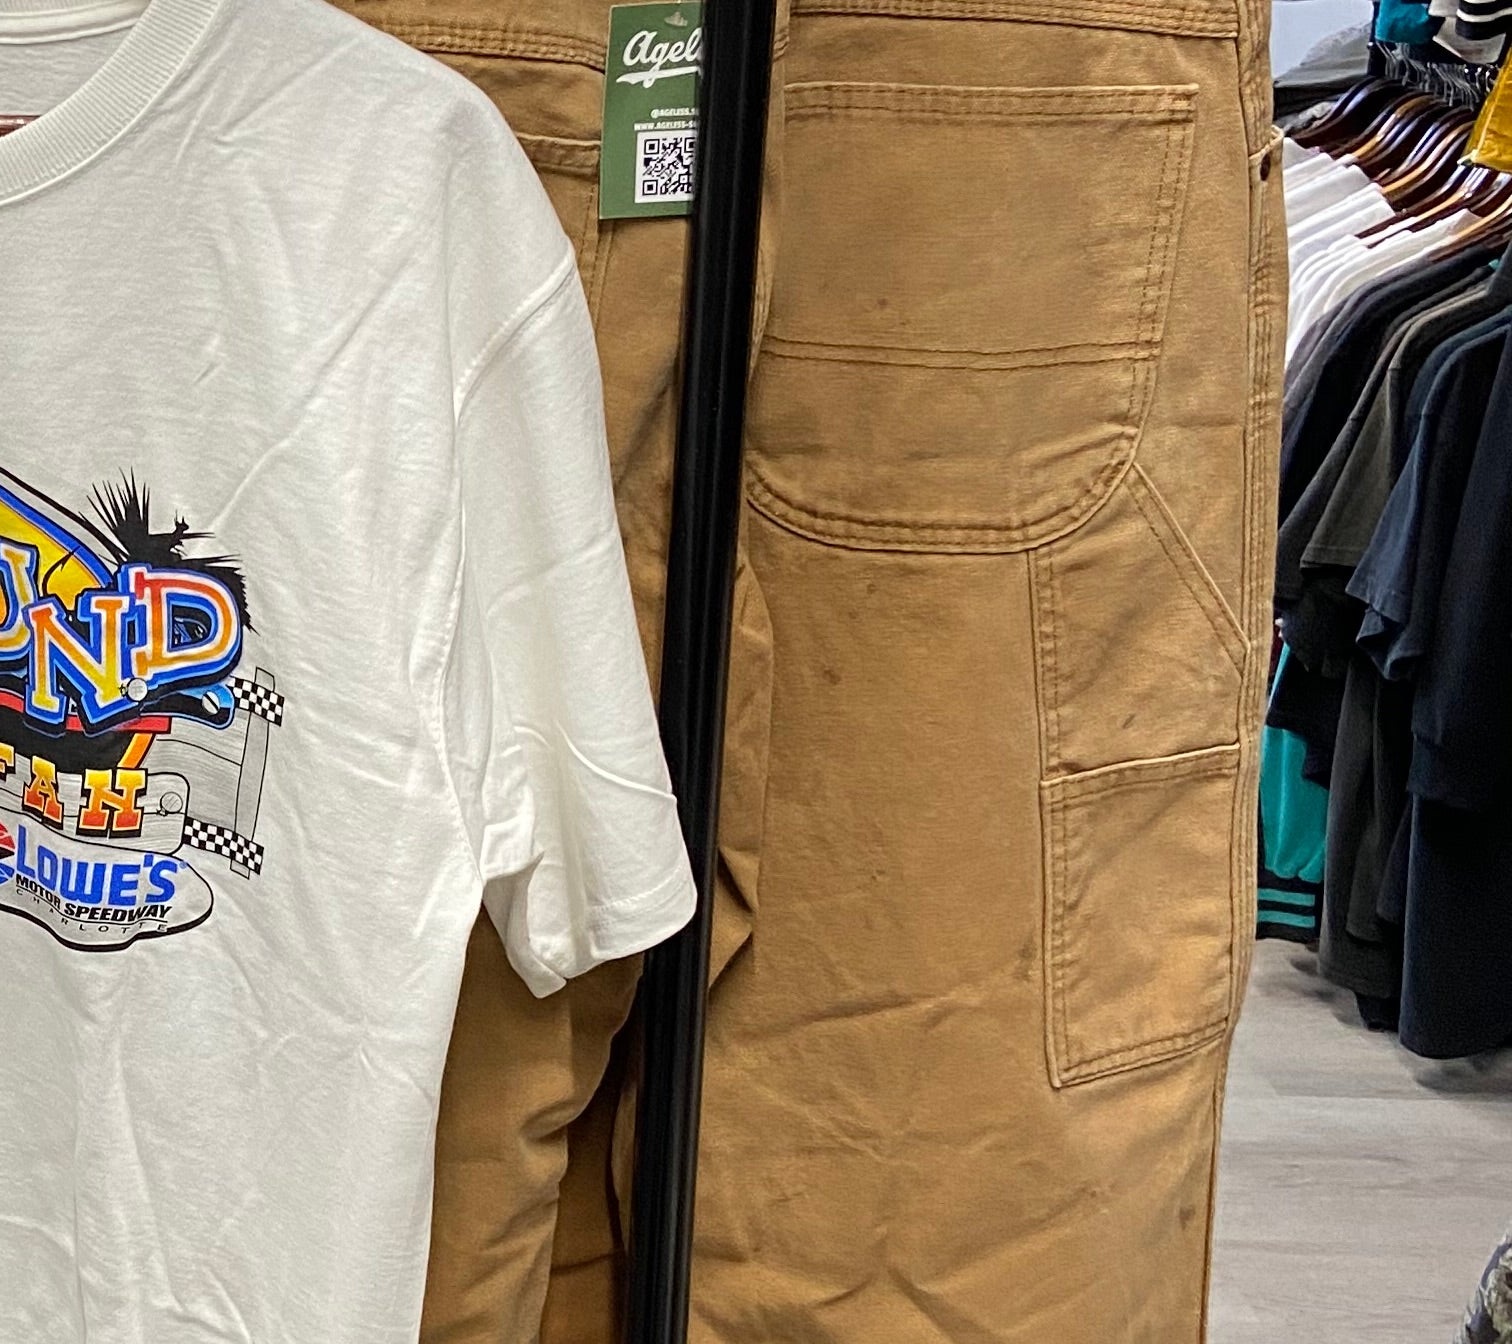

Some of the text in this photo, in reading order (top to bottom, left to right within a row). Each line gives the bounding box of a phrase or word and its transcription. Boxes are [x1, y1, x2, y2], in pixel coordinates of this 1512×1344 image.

[622, 27, 704, 89] Agel
[16, 823, 178, 906] LOWE'S
[15, 873, 173, 923] MOTOR SPEEDWAY
[16, 889, 169, 934] CHARLOTTE
